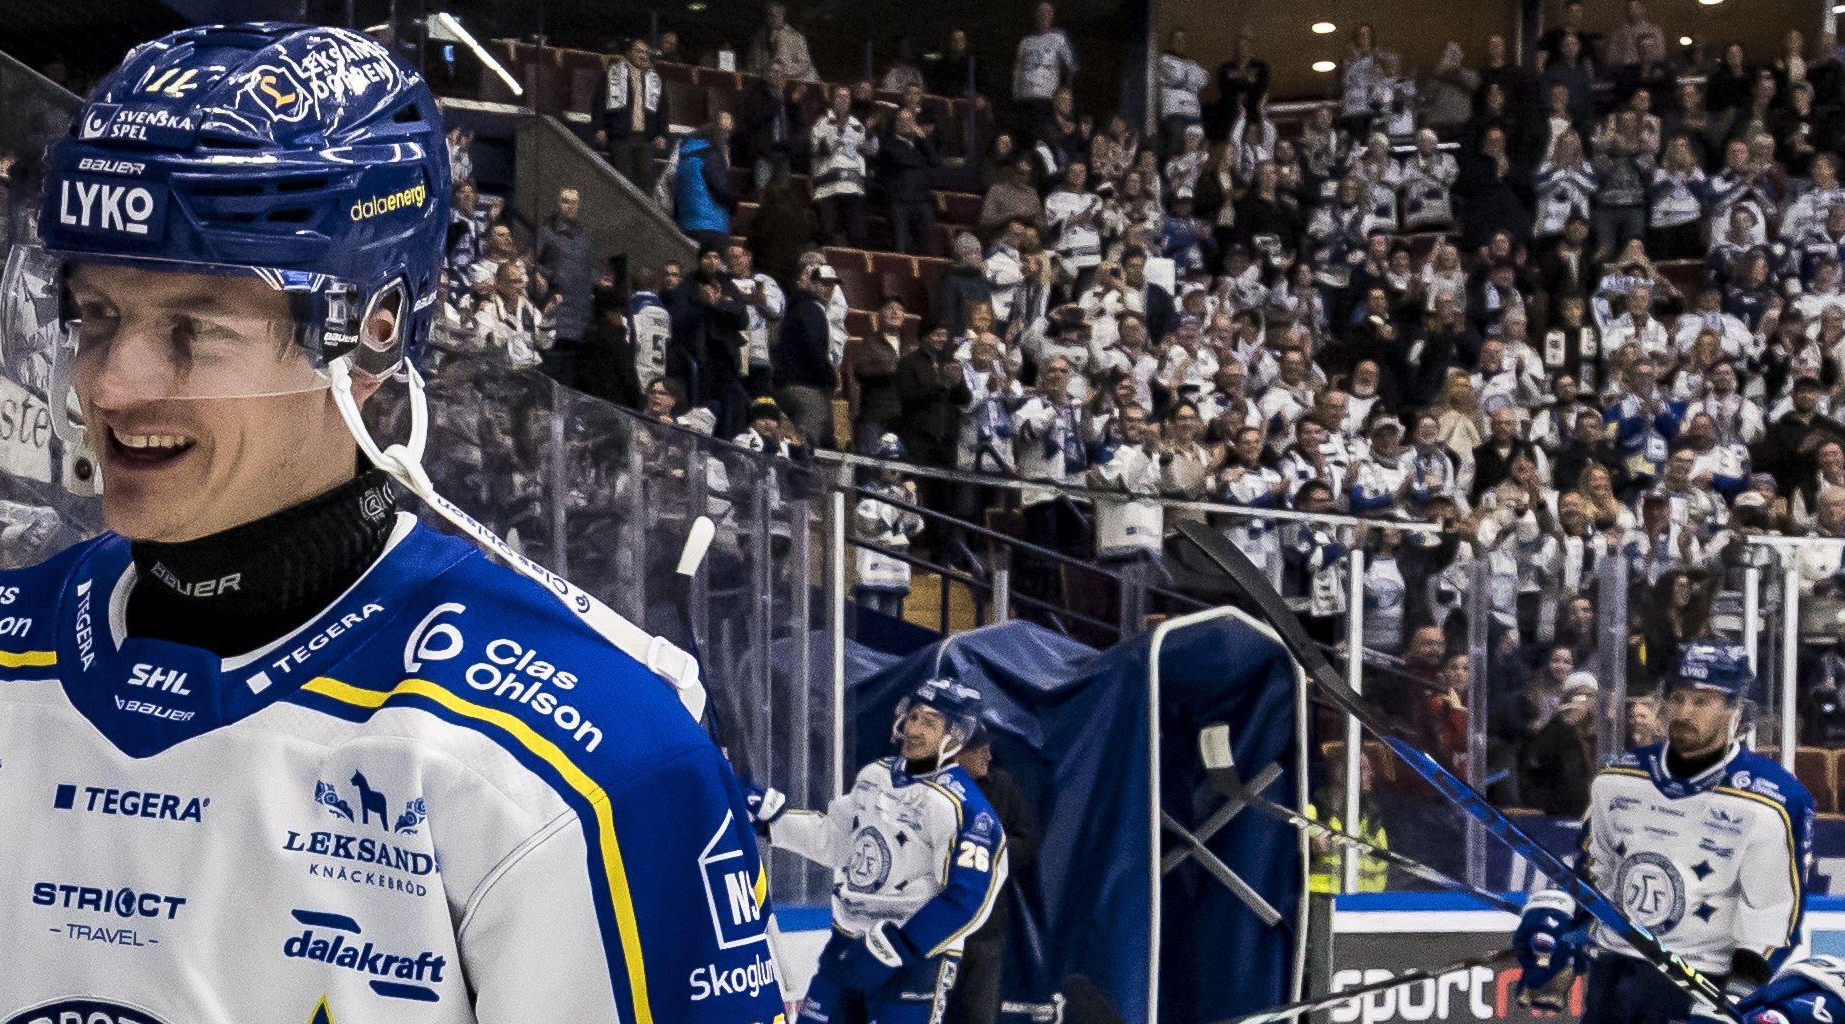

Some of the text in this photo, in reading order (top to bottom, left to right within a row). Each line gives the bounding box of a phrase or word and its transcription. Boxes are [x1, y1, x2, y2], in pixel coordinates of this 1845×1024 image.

[110, 124, 148, 140] SPEL
[116, 110, 192, 131] SVENSKA
[78, 157, 146, 175] BAUER
[60, 179, 154, 234] LYKO
[350, 180, 427, 221] dalaenergi
[149, 560, 242, 597] BAUER
[74, 593, 96, 673] TEGERA
[271, 601, 386, 676] TEGERA
[127, 661, 192, 696] SHL
[485, 637, 580, 692] Clas
[464, 661, 604, 754] Ohlson
[282, 830, 441, 877] LEKSAND
[956, 841, 990, 873] 26
[308, 862, 428, 898] KNÄCKEBRÖD
[66, 923, 145, 947] TRAVEL
[283, 929, 447, 984] dalakraft
